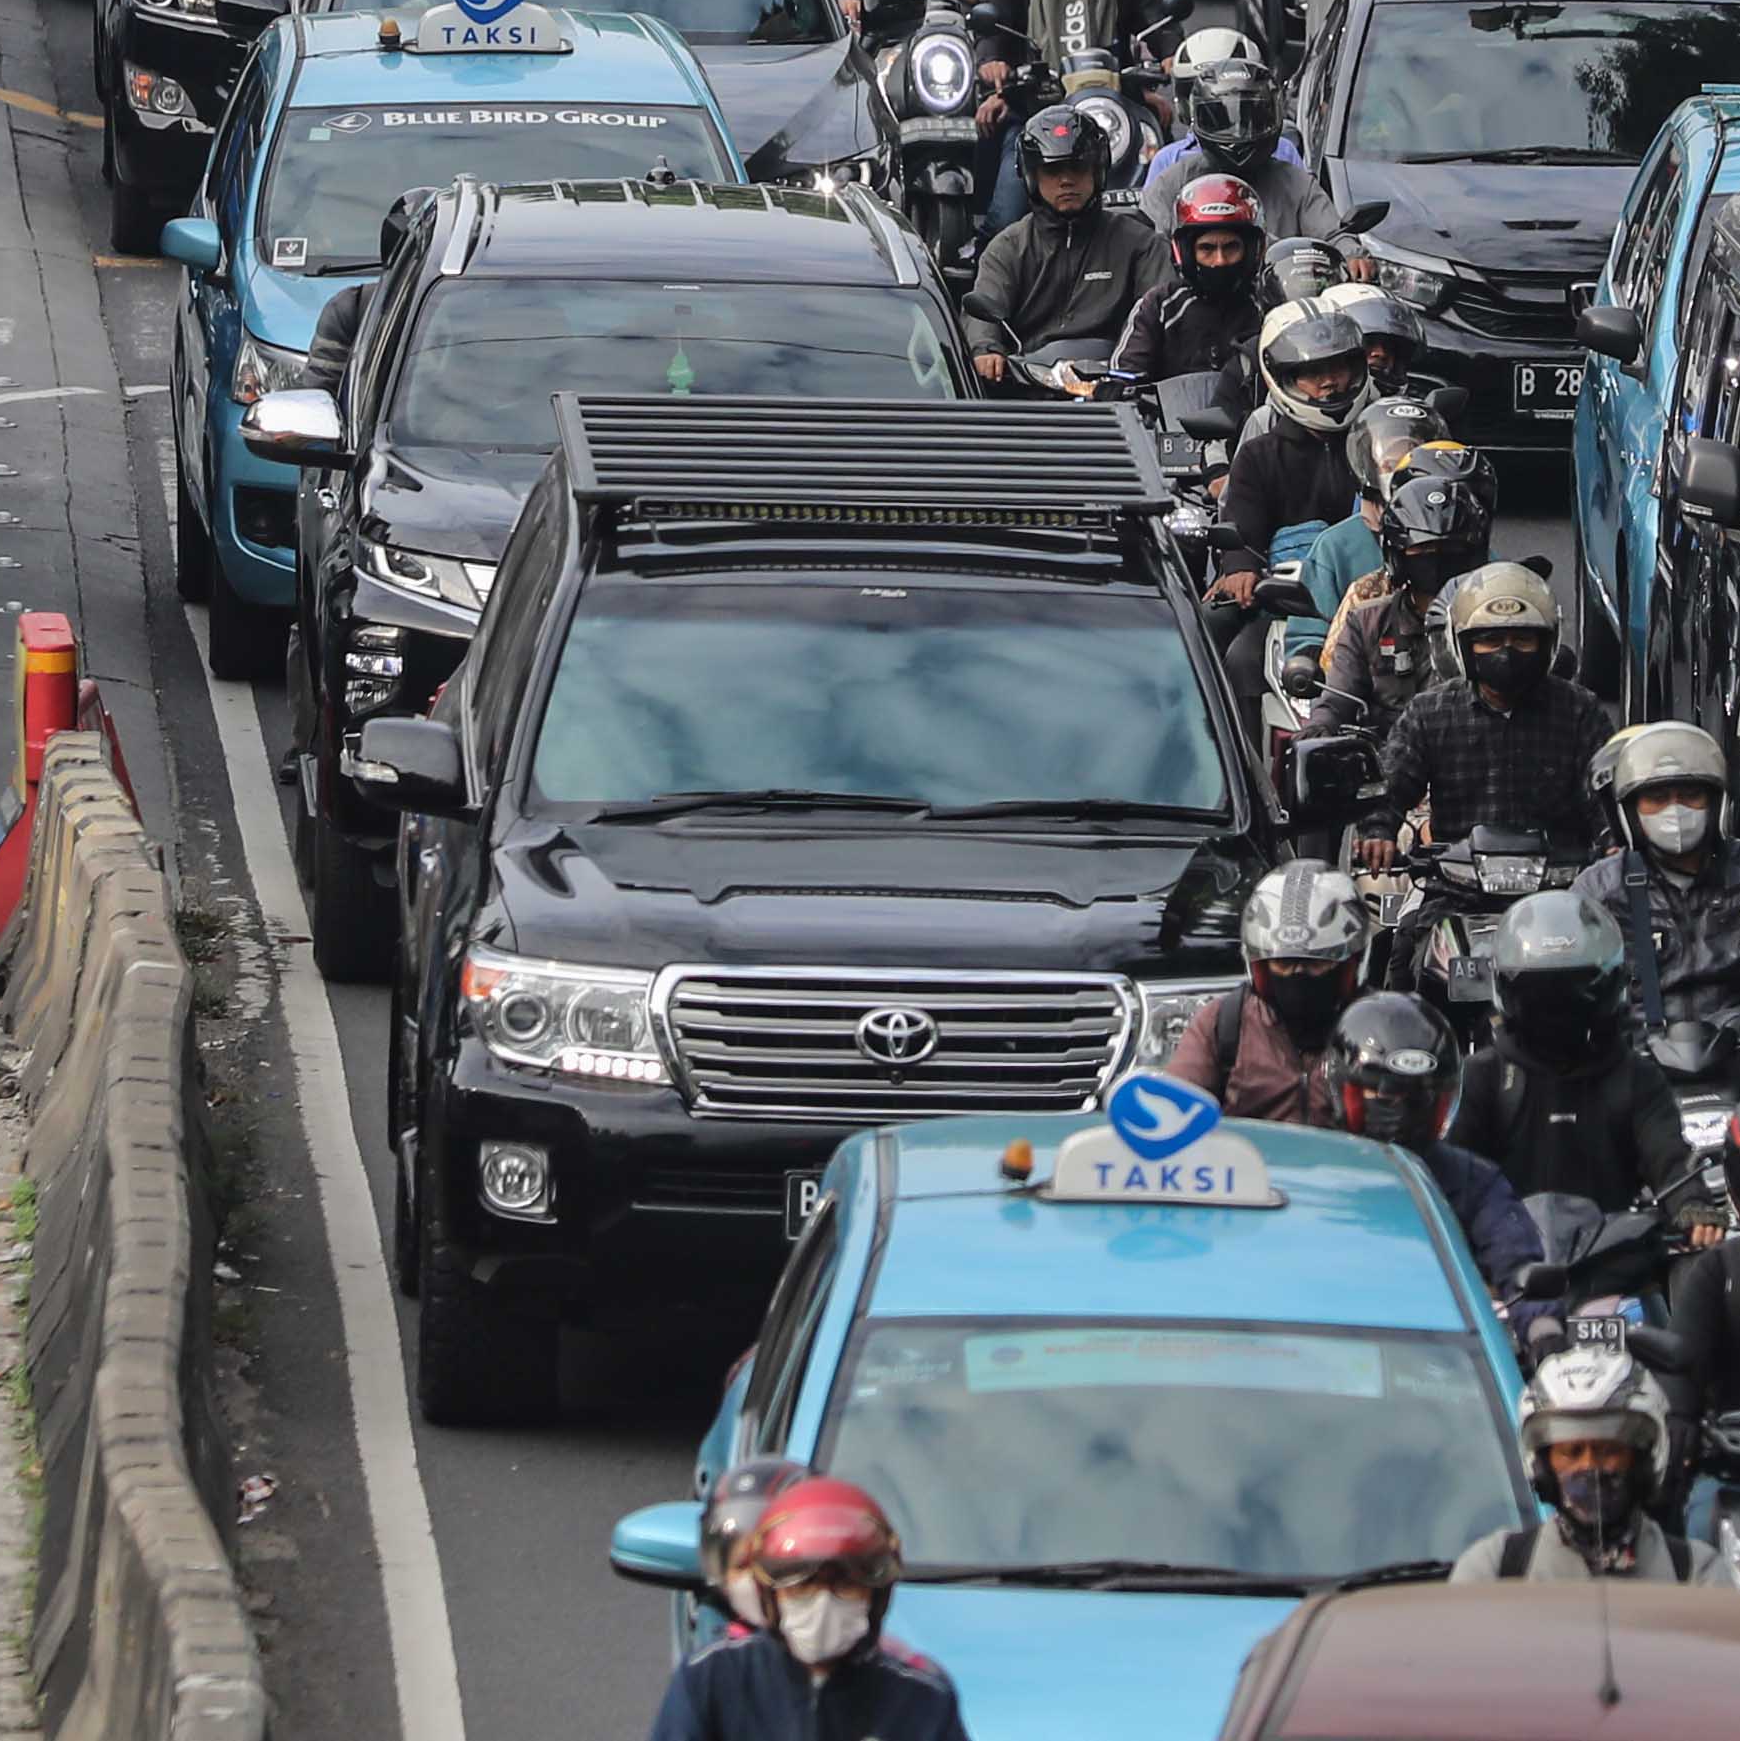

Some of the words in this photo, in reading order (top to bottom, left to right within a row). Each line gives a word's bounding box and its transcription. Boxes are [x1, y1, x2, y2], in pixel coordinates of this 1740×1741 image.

[441, 27, 536, 45] TAKSI
[383, 111, 463, 127] BLUE
[469, 110, 549, 126] BIRD
[555, 110, 667, 129] GROUP
[1521, 368, 1535, 396] B
[1163, 439, 1173, 453] B
[1385, 895, 1395, 909] T
[1093, 1164, 1235, 1193] TAKSI
